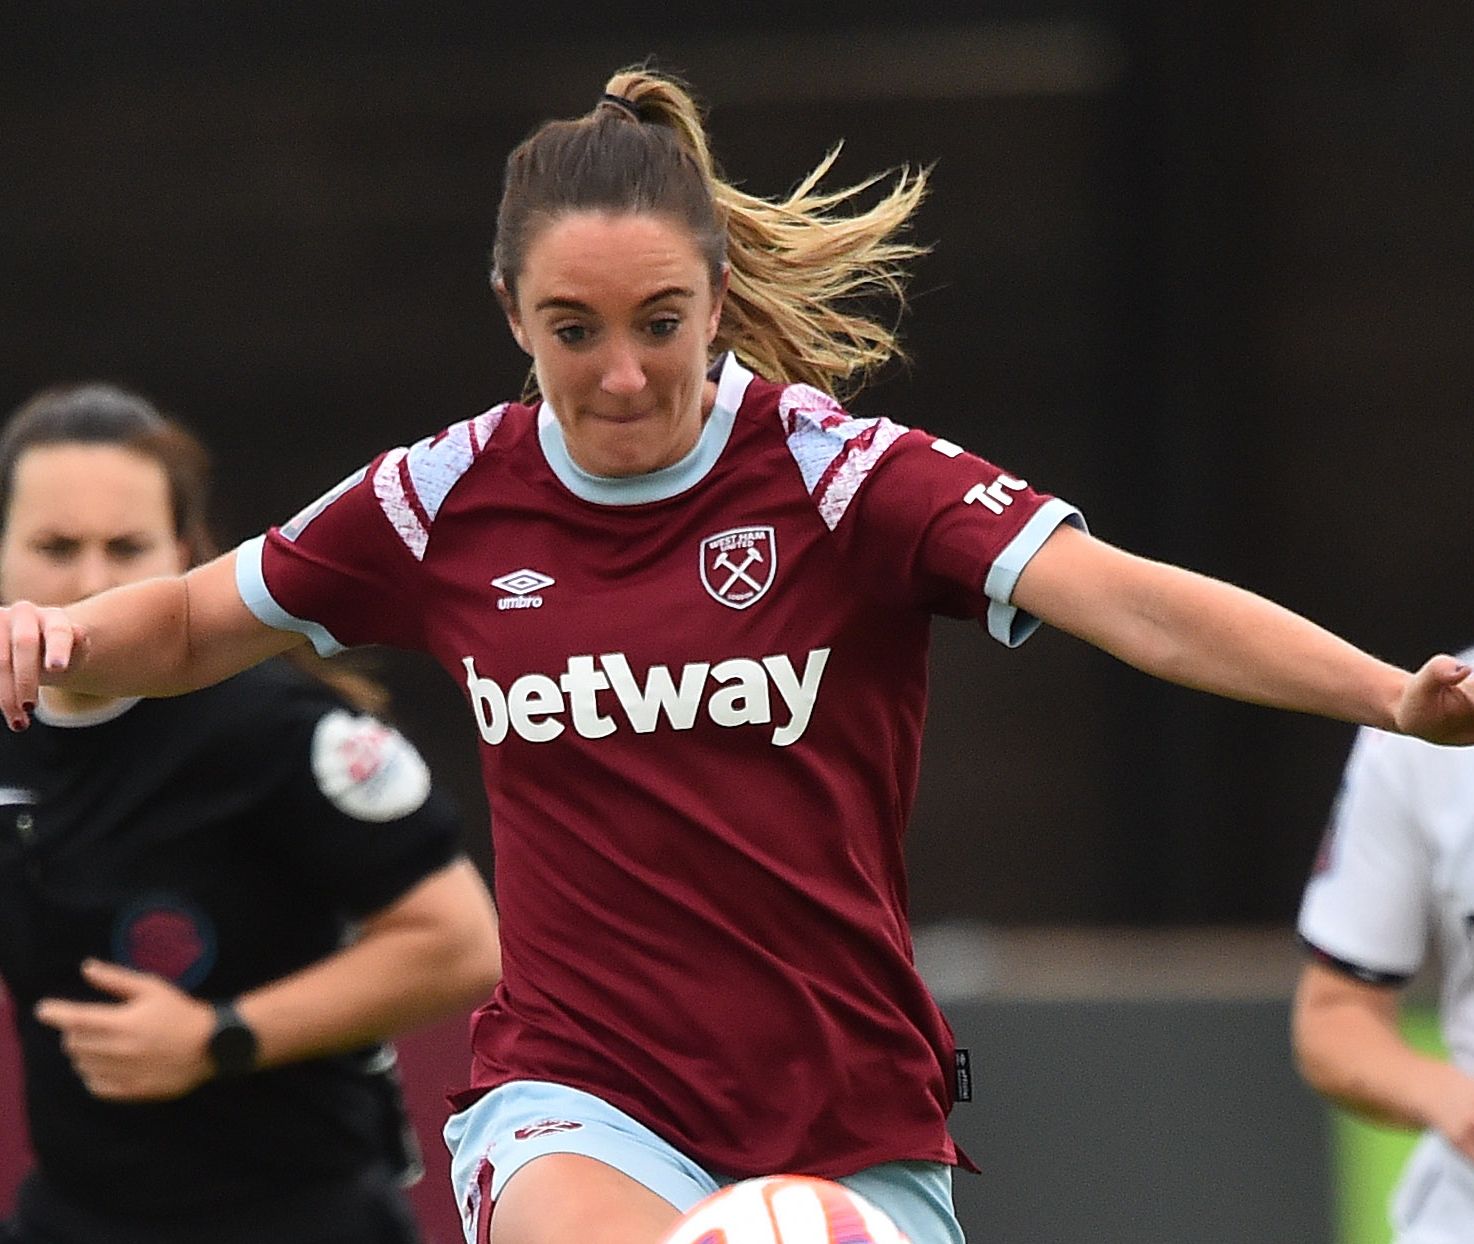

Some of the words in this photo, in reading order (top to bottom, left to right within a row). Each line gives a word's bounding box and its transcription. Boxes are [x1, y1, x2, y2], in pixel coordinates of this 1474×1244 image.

[708, 534, 738, 550] WEST
[738, 531, 766, 542] HAM
[720, 539, 755, 553] UNITED
[497, 595, 543, 611] umbro
[462, 647, 831, 747] betway
